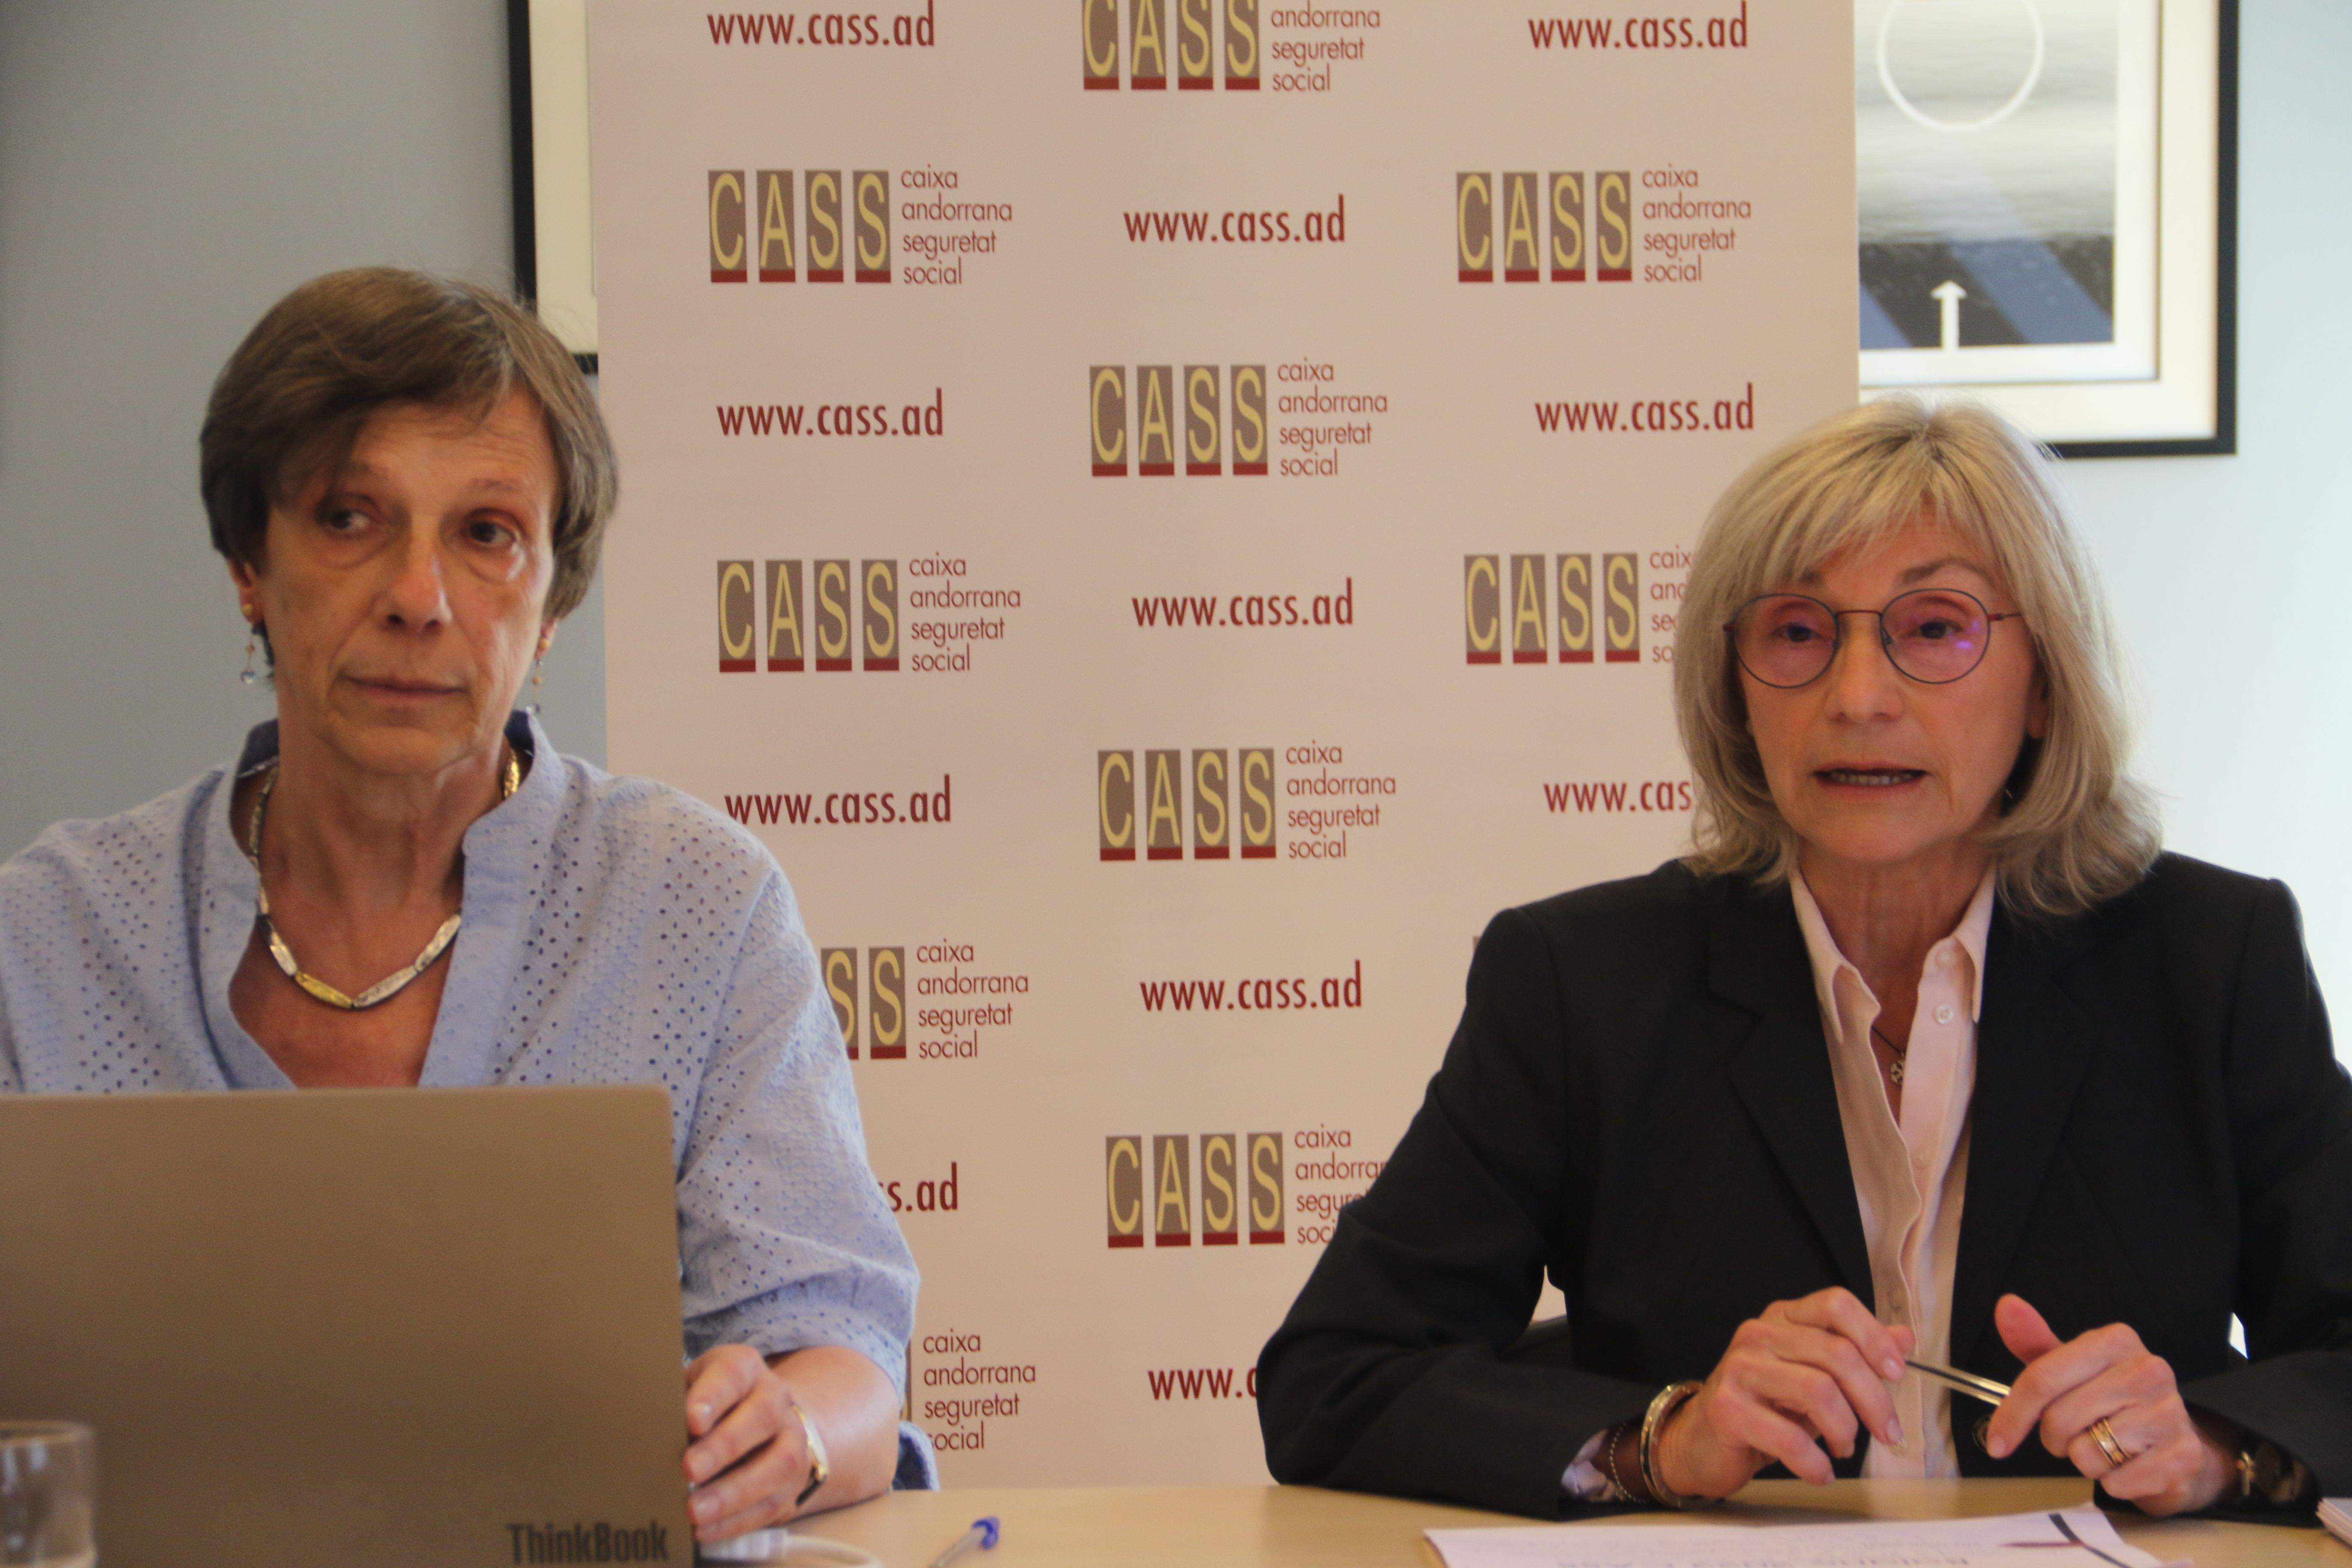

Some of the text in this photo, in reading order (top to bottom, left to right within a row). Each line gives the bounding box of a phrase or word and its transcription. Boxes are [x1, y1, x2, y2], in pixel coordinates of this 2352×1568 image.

[707, 0, 934, 47] www.cass.ad
[1270, 0, 1381, 29] andorrana
[1528, 0, 1747, 49] www.cass.ad
[1084, 0, 1258, 77] CASS
[1271, 37, 1365, 69] seguretat
[1272, 62, 1331, 92] social
[900, 163, 958, 189] caixa
[1642, 163, 1699, 189] caixa
[711, 173, 887, 270] CASS
[901, 191, 1013, 222] andorrana
[1123, 194, 1345, 242] www.cass.ad
[1458, 173, 1629, 270] CASS
[1642, 193, 1752, 220] andorrana
[903, 230, 997, 261] seguretat
[1644, 228, 1736, 257] seguretat
[903, 256, 962, 285] social
[1644, 254, 1702, 283] social
[1277, 357, 1334, 382] caixa
[716, 387, 943, 436] www.cass.ad
[1278, 384, 1388, 414] andorrana
[1534, 382, 1754, 432] www.cass.ad
[1092, 368, 1264, 463] CASS
[1279, 422, 1372, 453] seguretat
[1280, 447, 1338, 477] social
[909, 551, 967, 577] caixa
[1649, 544, 1694, 570] caix
[910, 579, 1021, 609] andorrana
[1131, 577, 1353, 627] www.cass.ad
[1466, 555, 1637, 651] CASS
[720, 562, 894, 658] CASS
[911, 617, 1005, 648] seguretat
[912, 642, 971, 672] social
[1285, 739, 1342, 765] caixa
[1286, 767, 1396, 796] andorrana
[1543, 781, 1692, 813] www.cas
[724, 774, 951, 825] www.cass.ad
[1100, 750, 1272, 848] CASS
[1288, 803, 1381, 836] seguretat
[1288, 830, 1347, 860] social
[916, 938, 974, 963] caixa
[917, 966, 1029, 996] andorrana
[1139, 959, 1362, 1012] www.cass.ad
[827, 949, 902, 1045] SS
[918, 1003, 1013, 1035] seguretat
[919, 1030, 978, 1060] social
[1294, 1123, 1351, 1149] caixa
[1108, 1136, 1281, 1234] CASS
[922, 1328, 981, 1354] caixa
[923, 1356, 1036, 1387] andorrana
[925, 1393, 1020, 1427] seguretat
[505, 1520, 668, 1564] ThinkBook
